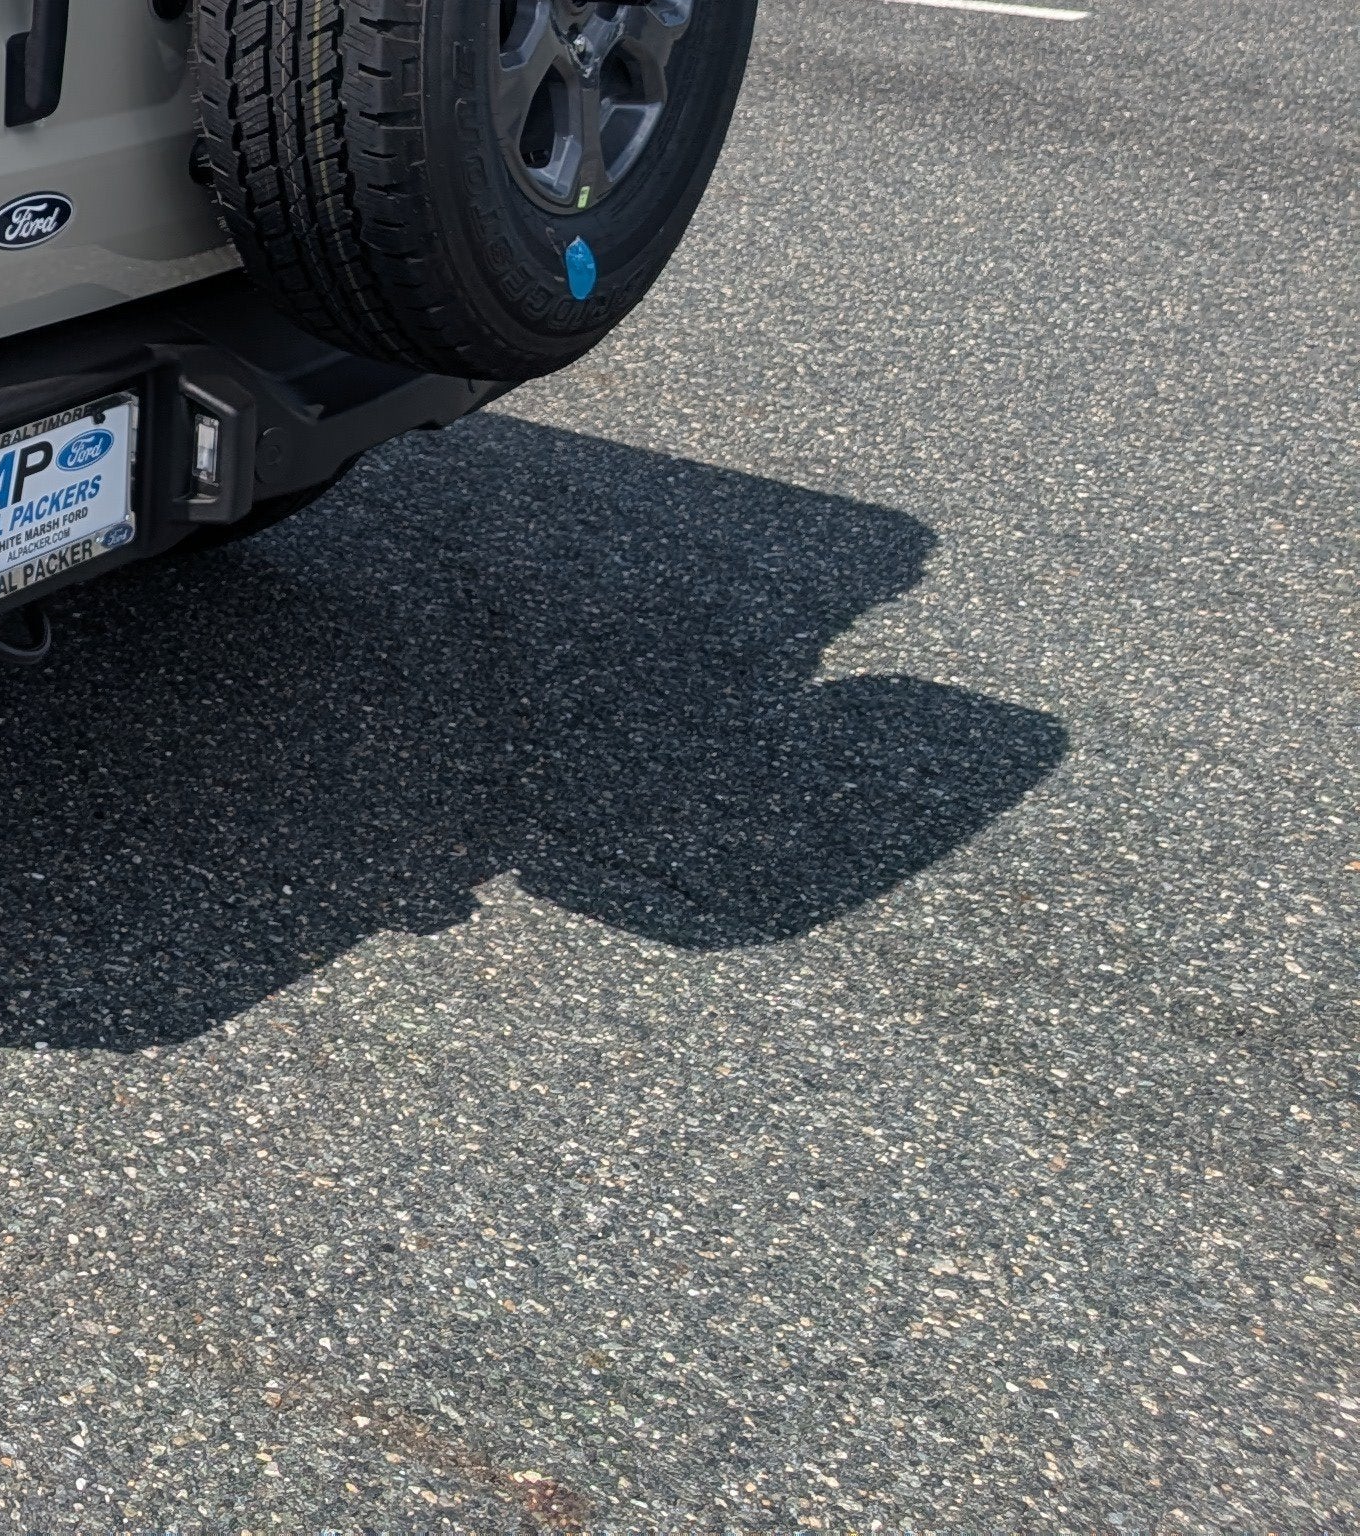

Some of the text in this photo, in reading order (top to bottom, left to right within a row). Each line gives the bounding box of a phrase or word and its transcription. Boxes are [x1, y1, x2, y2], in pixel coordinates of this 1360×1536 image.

[3, 202, 61, 241] Ford
[0, 405, 92, 447] BALTIMORE
[66, 434, 104, 467] Ford
[8, 474, 102, 532] PACKERS
[24, 517, 60, 541] MARSH
[62, 506, 89, 527] FORD
[7, 527, 71, 562] ALPACKER.COM
[22, 538, 93, 586] PACKER
